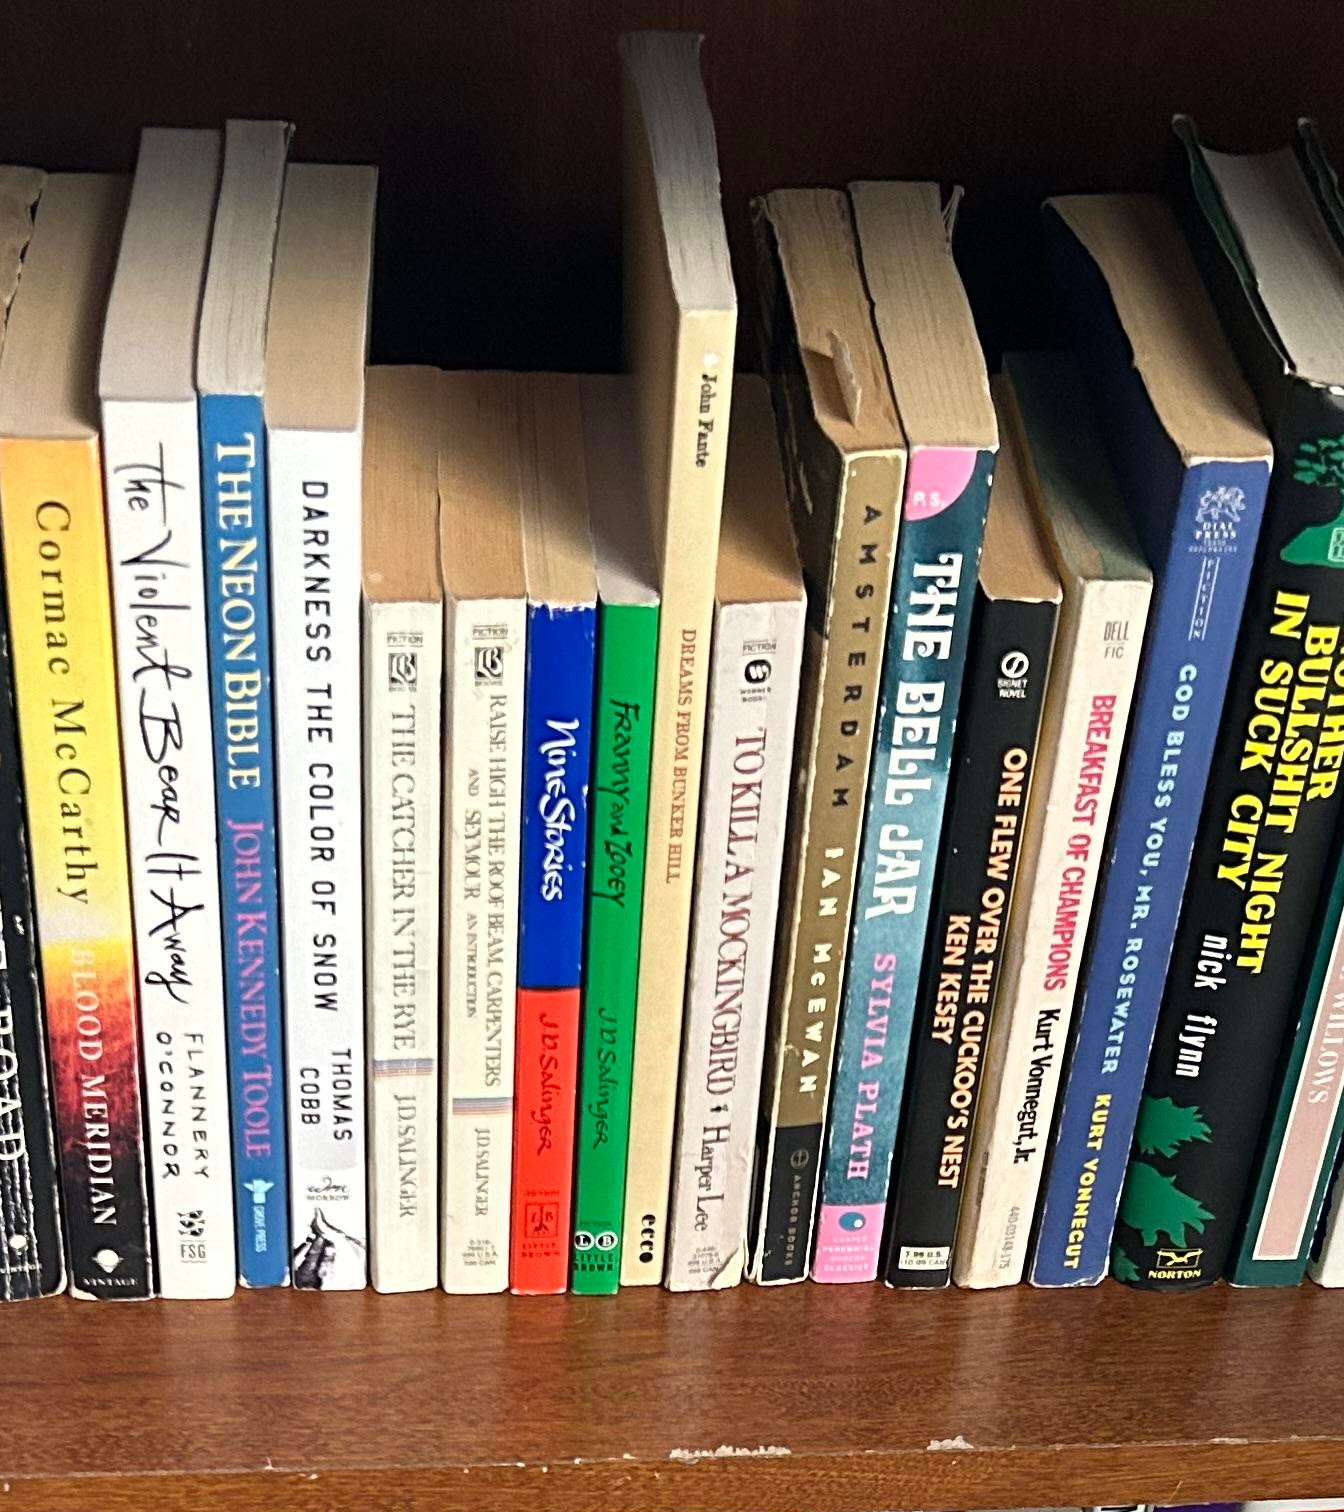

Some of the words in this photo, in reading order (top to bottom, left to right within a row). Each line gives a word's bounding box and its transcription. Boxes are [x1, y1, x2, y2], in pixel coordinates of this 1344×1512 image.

[700, 373, 718, 413] John
[213, 432, 255, 528] THE
[694, 416, 714, 469] Fante
[219, 538, 259, 664] NEON
[1104, 620, 1129, 642] DELL
[1269, 590, 1310, 639] IN
[1105, 646, 1124, 659] FIC
[224, 672, 262, 790] BIBLE
[1240, 659, 1294, 774] SUCK
[1268, 624, 1340, 834] BULLSHIT
[1217, 796, 1265, 889] CITY
[1234, 850, 1285, 974] NIGHT
[67, 947, 103, 1062] BLOOD
[1193, 934, 1229, 991] nick
[861, 952, 897, 1070] SYLVIA
[1175, 1008, 1219, 1079] flynn
[78, 1074, 116, 1226] MERIDIAN
[846, 1081, 882, 1181] PLATH
[1148, 1269, 1202, 1280] NORTON
